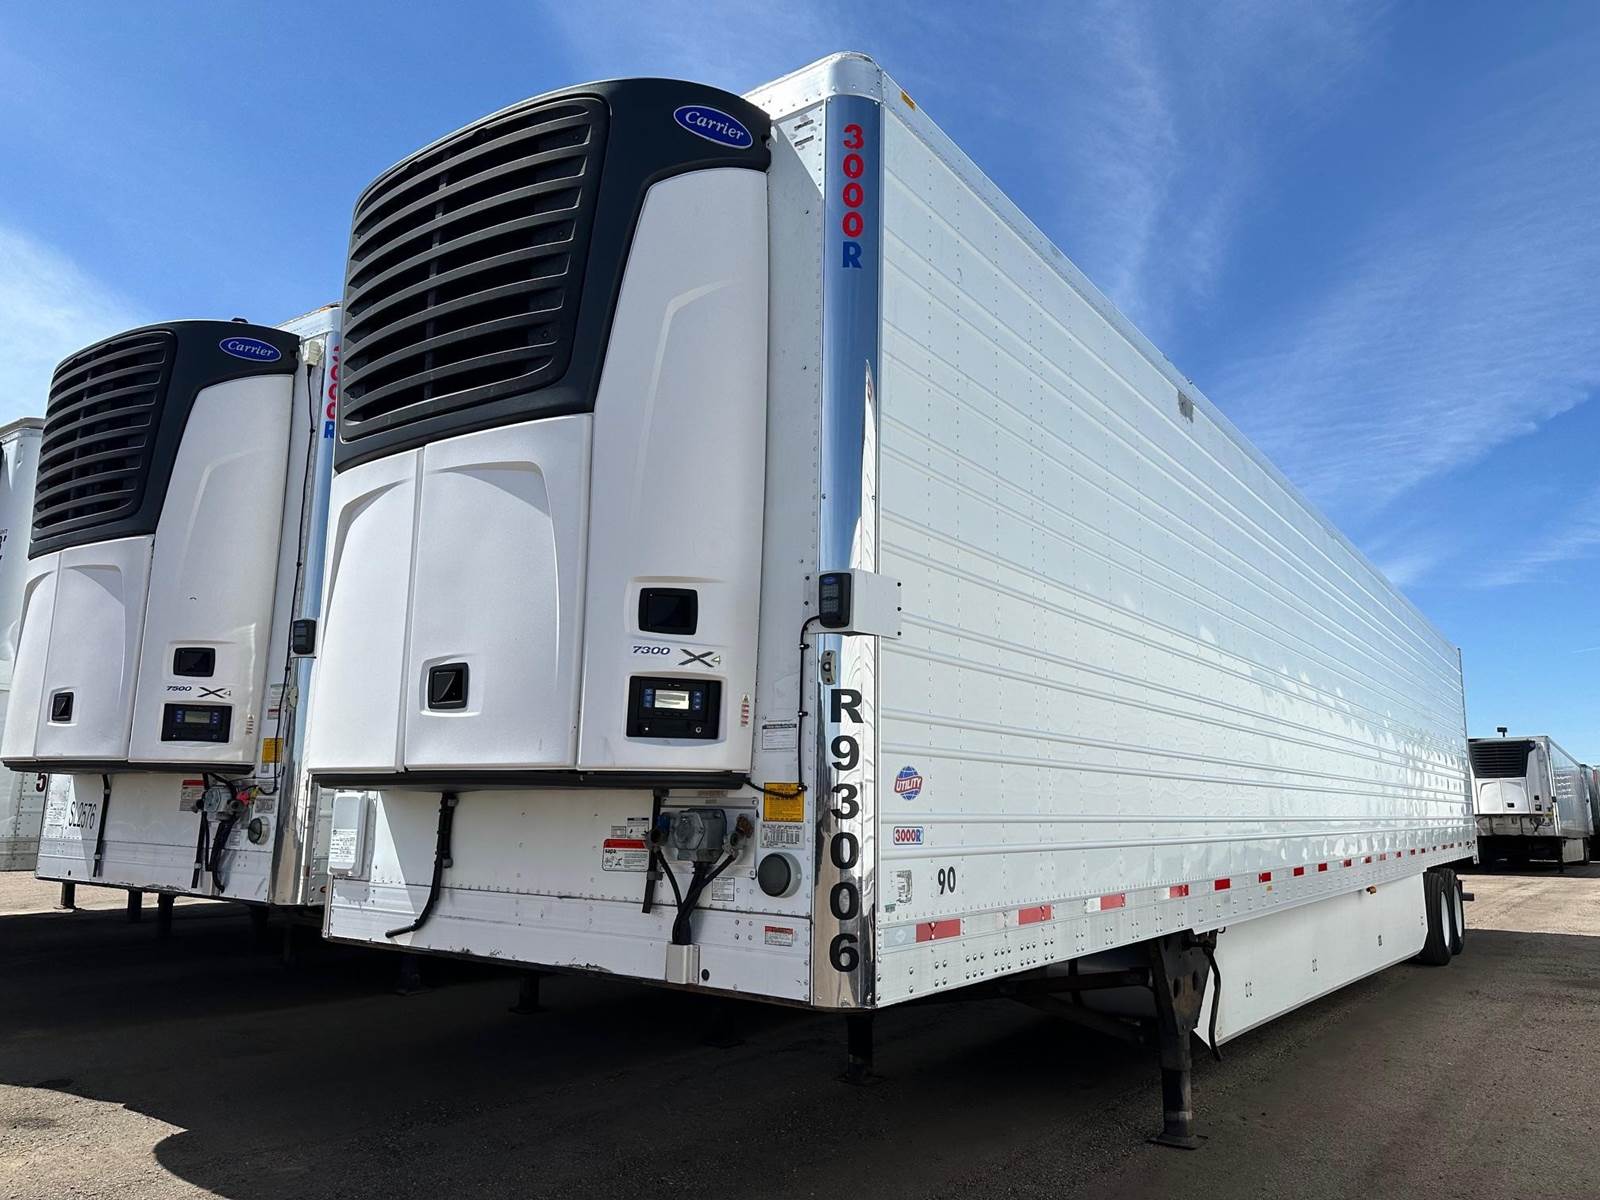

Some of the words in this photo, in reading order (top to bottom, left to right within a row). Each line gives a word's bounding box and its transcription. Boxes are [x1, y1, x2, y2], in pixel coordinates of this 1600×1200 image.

[684, 111, 744, 141] Carrier
[842, 123, 864, 269] 3000R
[228, 340, 274, 357] Carrier
[632, 646, 671, 655] 7300
[896, 777, 922, 792] UTILITY
[829, 688, 864, 973] R93006
[895, 828, 921, 843] 3000R
[937, 866, 956, 895] 90
